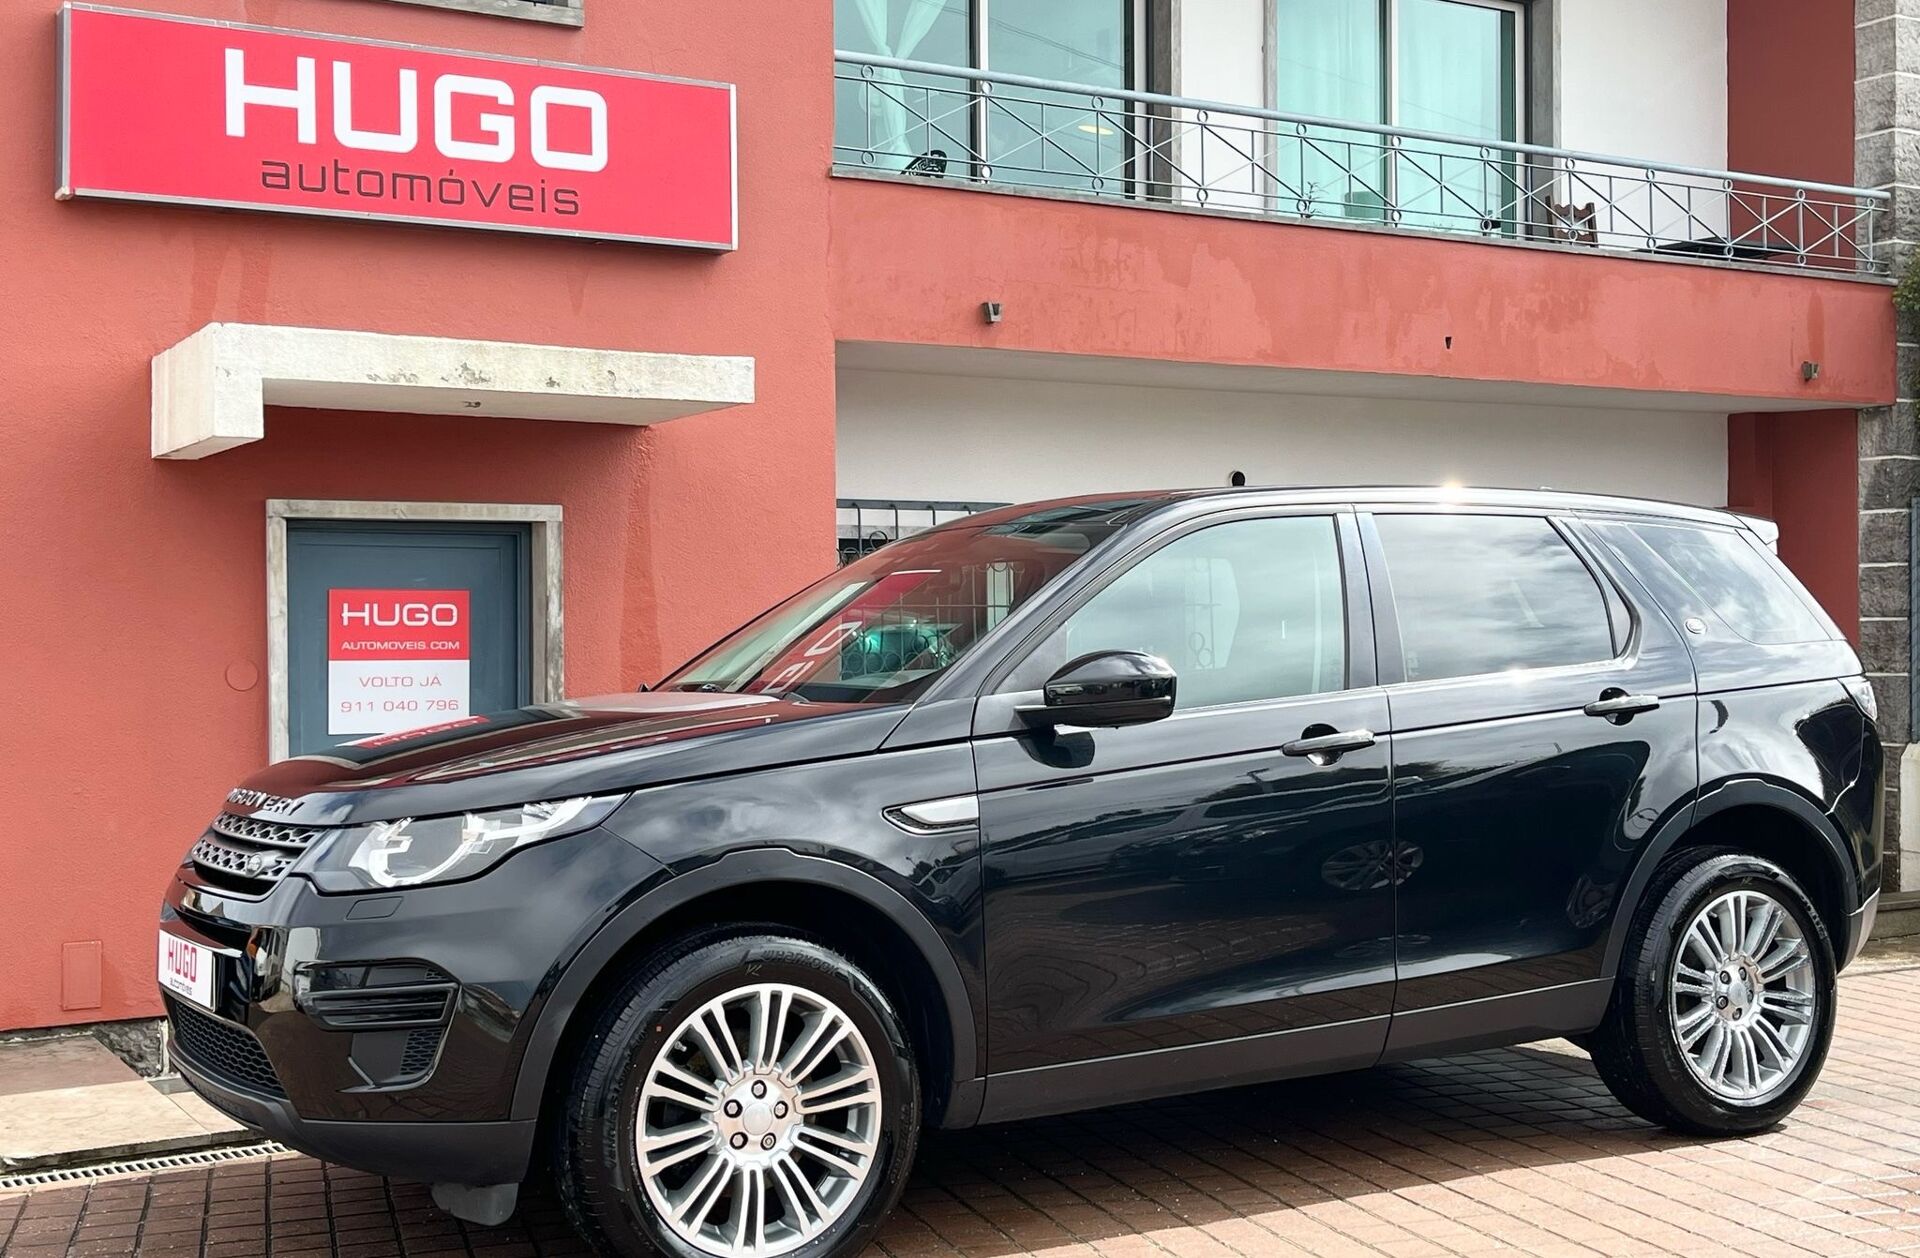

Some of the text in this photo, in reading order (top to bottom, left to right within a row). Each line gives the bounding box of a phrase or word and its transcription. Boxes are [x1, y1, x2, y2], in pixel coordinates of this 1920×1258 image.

[225, 48, 608, 172] HUGO
[261, 160, 579, 215] automóveis
[341, 602, 458, 627] HUGO
[341, 640, 460, 651] AUTOMOVEIS.COM
[359, 673, 442, 688] VOLTO JÁ
[341, 699, 459, 713] 911 040 796
[168, 937, 197, 983] HUGO
